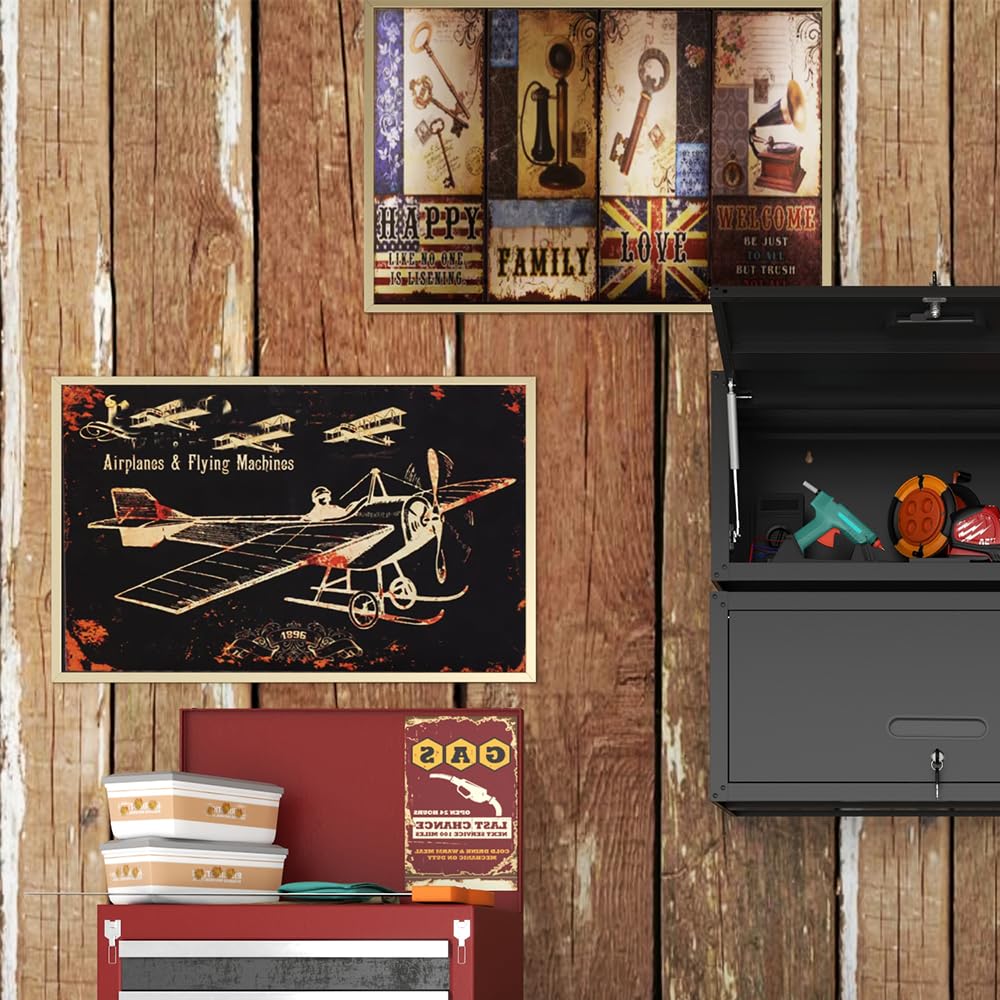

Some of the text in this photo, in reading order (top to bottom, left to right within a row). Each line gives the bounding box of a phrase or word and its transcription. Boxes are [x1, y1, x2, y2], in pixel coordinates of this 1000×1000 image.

[378, 205, 479, 240] HAPPY
[716, 204, 817, 232] WELCOME
[619, 230, 688, 265] LOVE
[743, 236, 789, 246] BE JUST
[388, 252, 464, 265] LIKE NO ONE
[497, 245, 590, 278] FAMILY
[390, 271, 402, 286] IS
[736, 265, 757, 275] BUT
[103, 453, 295, 475] Airplanes & Flying Machines
[282, 630, 307, 640] 1896
